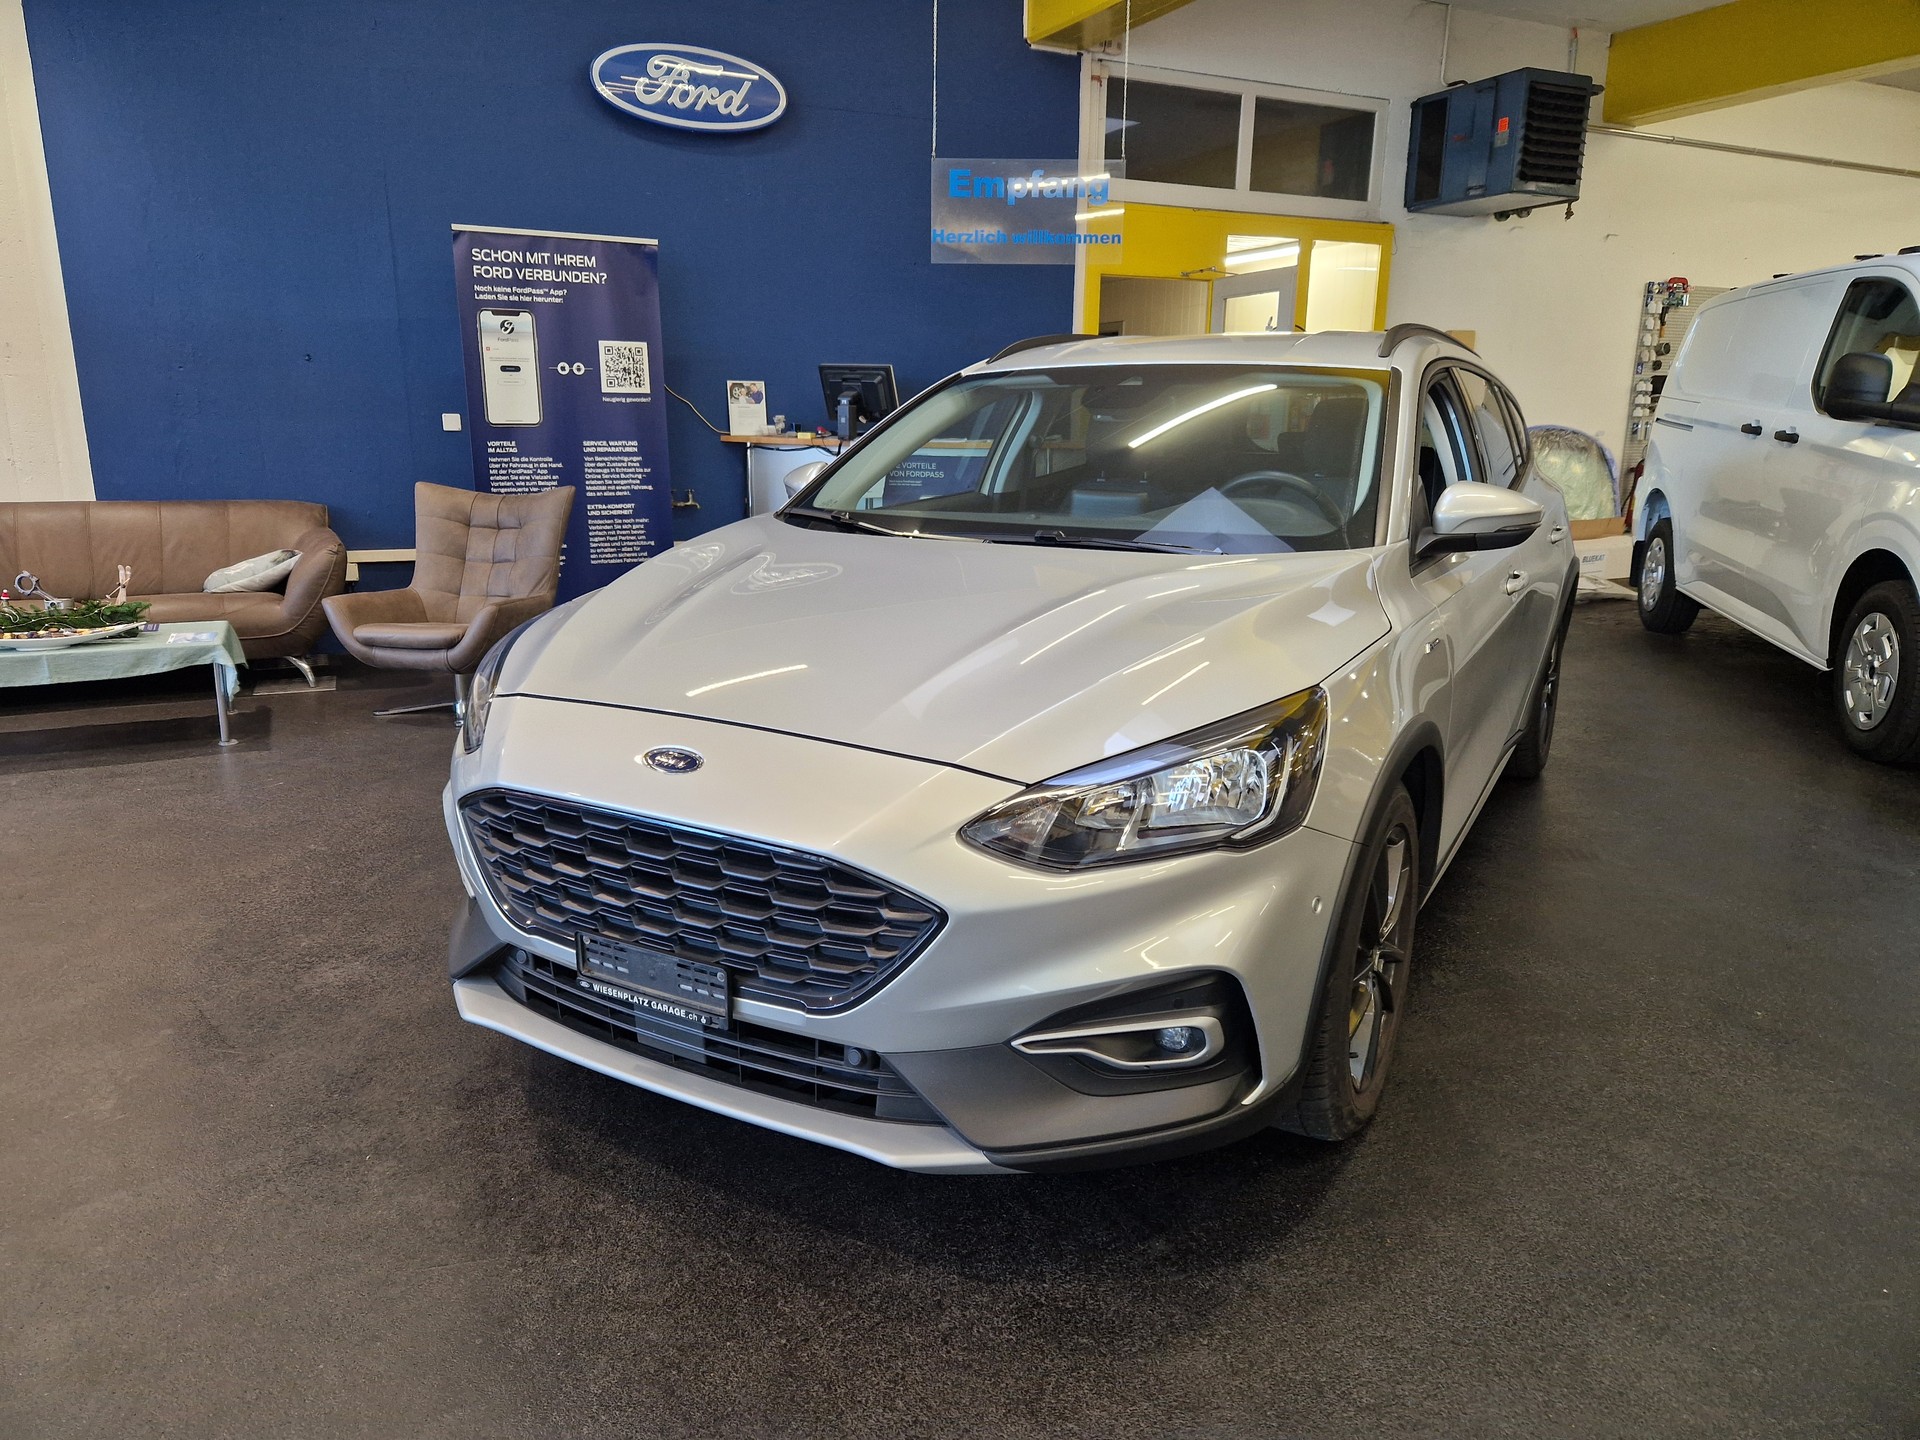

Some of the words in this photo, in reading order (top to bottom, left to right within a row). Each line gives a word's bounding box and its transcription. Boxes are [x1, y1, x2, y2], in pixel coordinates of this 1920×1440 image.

[635, 54, 751, 117] Ford
[949, 169, 1110, 206] Empfang
[932, 228, 1007, 245] Herzlich
[1012, 230, 1121, 245] willkommen
[472, 248, 522, 263] SCHON
[526, 252, 550, 264] MIT
[554, 253, 596, 268] IHREM
[473, 265, 512, 279] FORD
[515, 268, 607, 284] VERBUNDEN?
[592, 983, 649, 1007] WIESENPLATZ
[651, 1001, 698, 1022] GARAGE.ch
